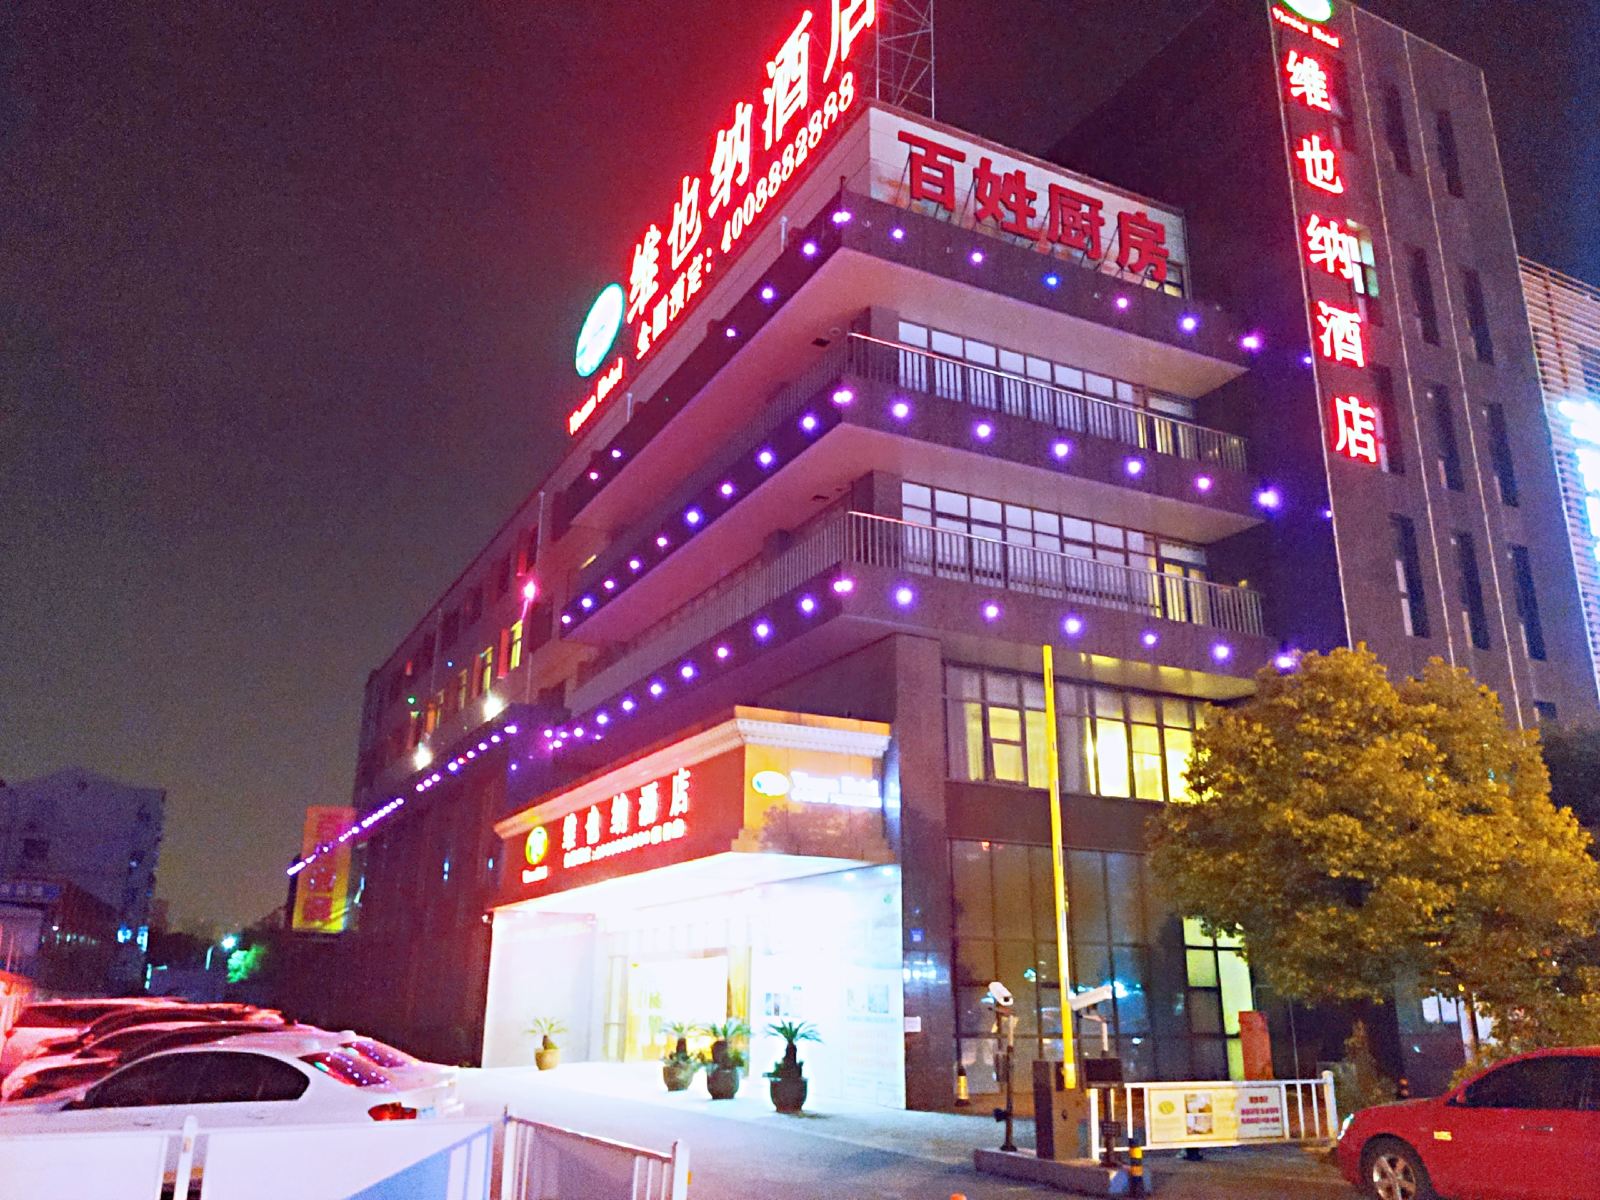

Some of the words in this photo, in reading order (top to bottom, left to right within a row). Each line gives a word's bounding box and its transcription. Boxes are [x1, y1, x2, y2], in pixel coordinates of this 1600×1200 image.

[897, 129, 1170, 282] 百姓厨房
[1286, 50, 1377, 464] 维也纳酒店
[561, 767, 691, 851] 纳酒店
